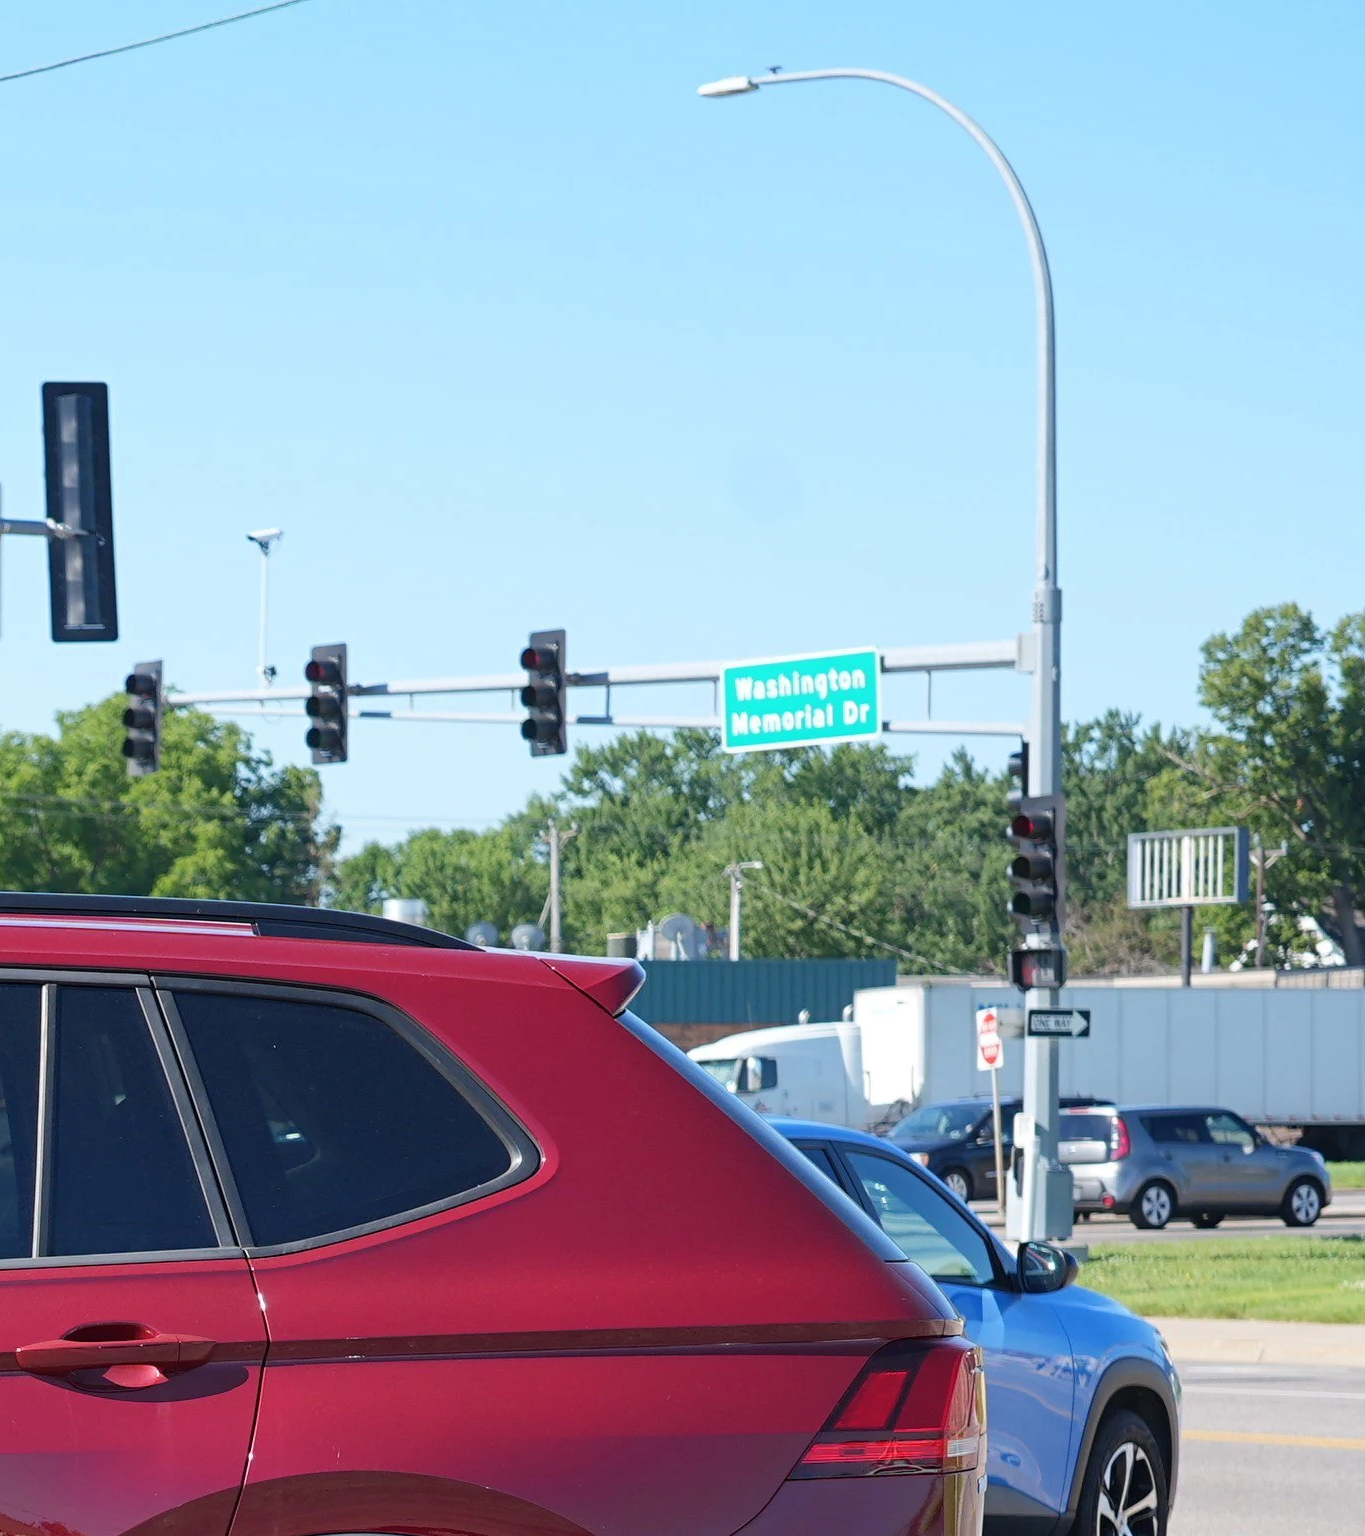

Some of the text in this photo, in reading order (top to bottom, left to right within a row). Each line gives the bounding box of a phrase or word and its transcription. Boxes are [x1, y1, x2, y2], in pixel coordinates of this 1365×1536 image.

[734, 667, 867, 700] Washington
[731, 699, 871, 737] Memorial Dr
[1033, 1016, 1071, 1030] ONE WAY
